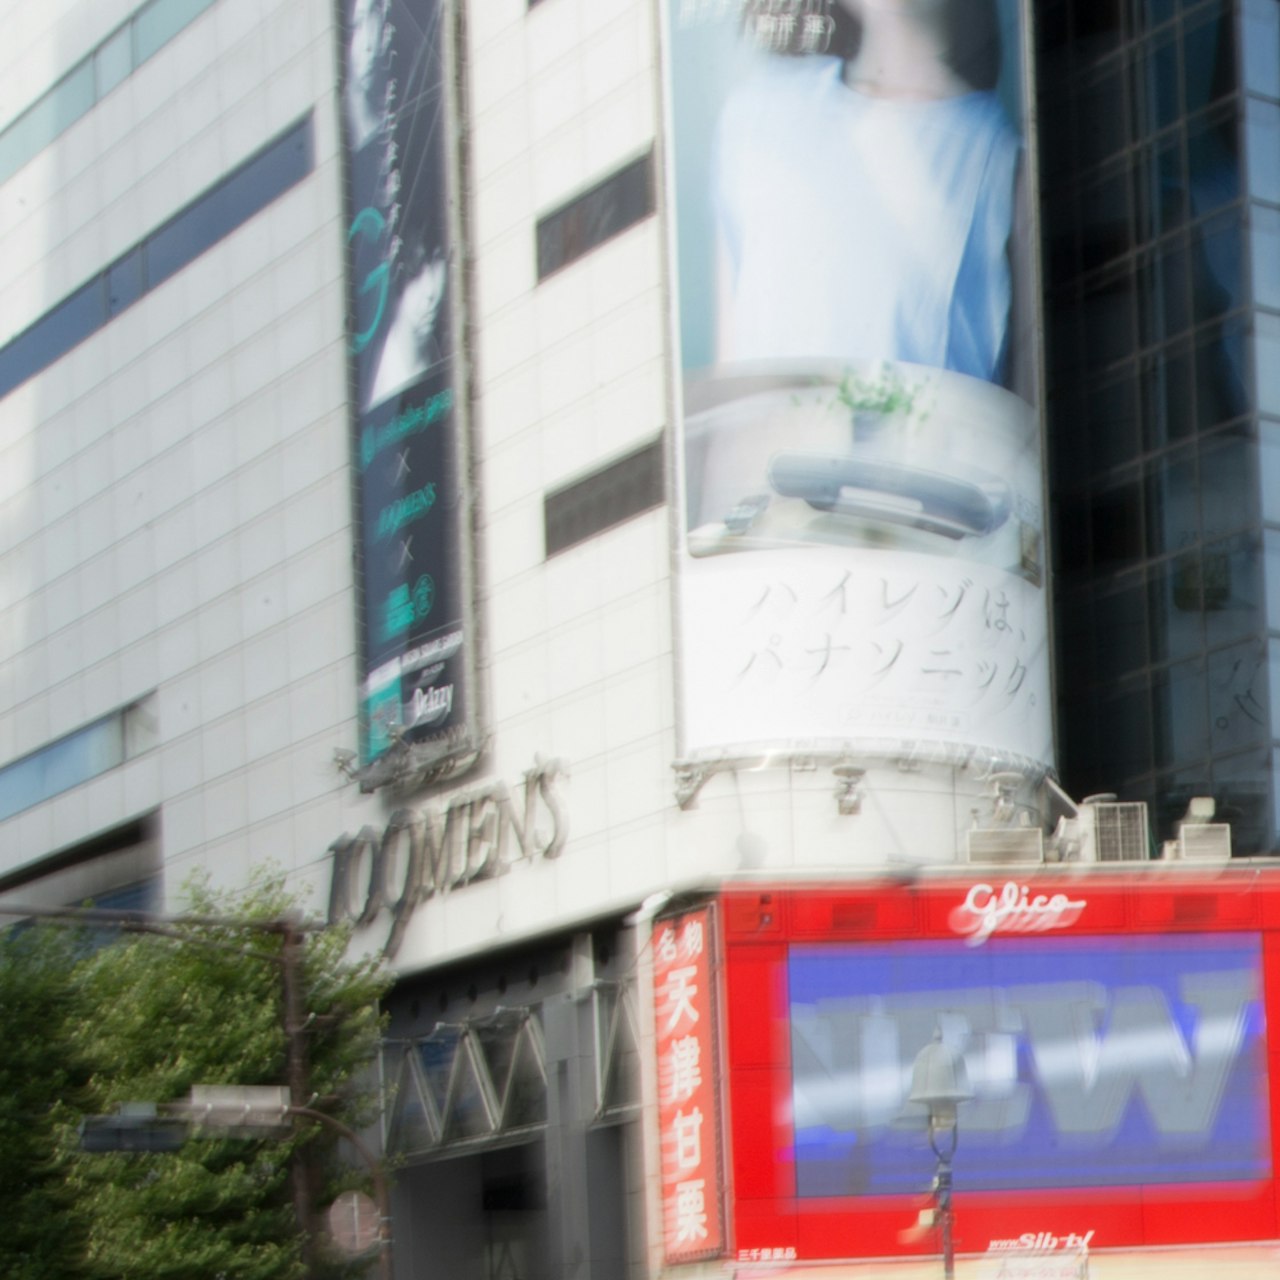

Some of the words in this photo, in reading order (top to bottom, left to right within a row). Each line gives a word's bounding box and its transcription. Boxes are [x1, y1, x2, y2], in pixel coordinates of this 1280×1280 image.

[656, 920, 704, 962] 名物
[664, 964, 707, 1242] 天津甘栗
